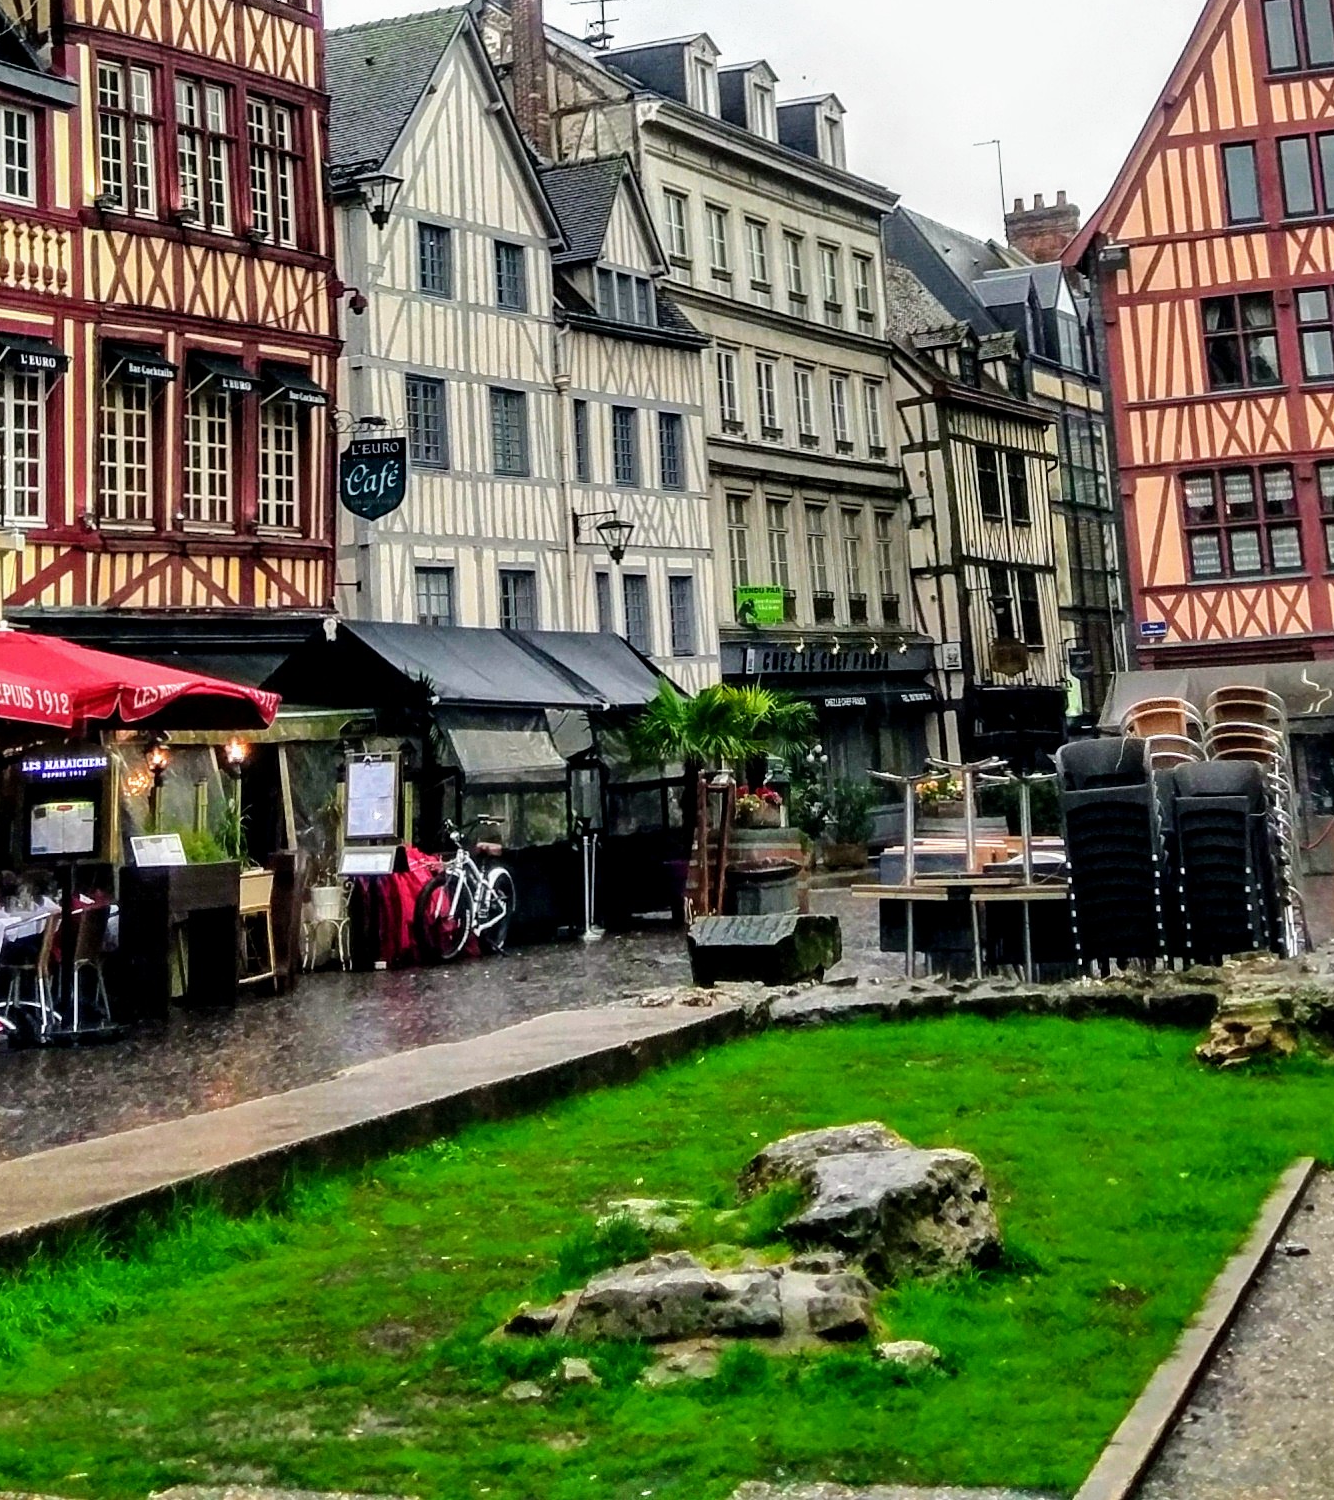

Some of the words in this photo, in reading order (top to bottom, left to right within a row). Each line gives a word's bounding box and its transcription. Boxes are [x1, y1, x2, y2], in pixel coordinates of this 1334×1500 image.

[20, 353, 56, 368] L'EURO
[351, 441, 400, 456] L'EURO
[345, 460, 399, 498] Café
[35, 689, 70, 716] 1912
[134, 686, 159, 709] LES
[22, 761, 41, 772] LES
[44, 757, 107, 771] MARAICHERS
[42, 771, 67, 779] DEPUIS
